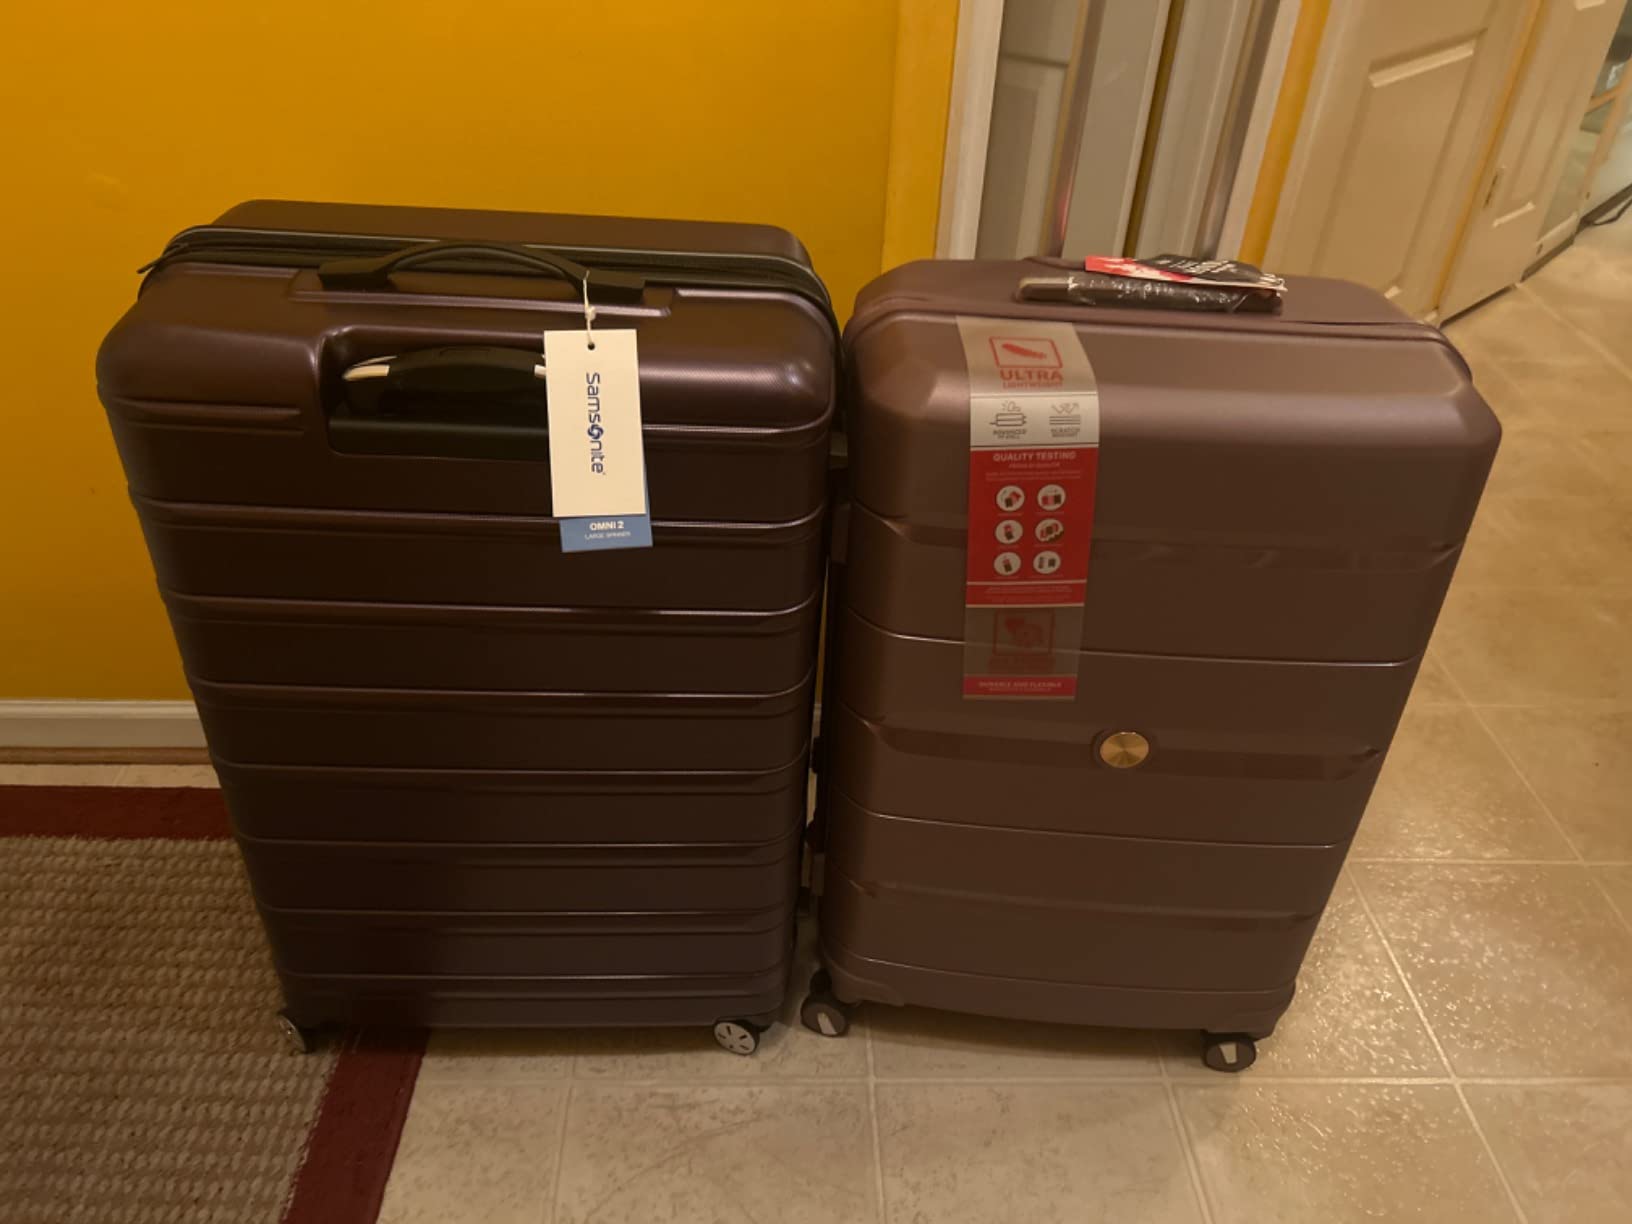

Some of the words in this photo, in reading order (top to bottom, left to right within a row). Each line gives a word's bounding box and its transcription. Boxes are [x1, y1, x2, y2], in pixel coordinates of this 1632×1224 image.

[999, 368, 1064, 381] ULTRA
[586, 372, 605, 474] Samsonite
[992, 452, 1033, 462] QUALITY
[1035, 450, 1077, 460] TESTING
[589, 522, 616, 531] OMNI
[617, 520, 624, 529] 2
